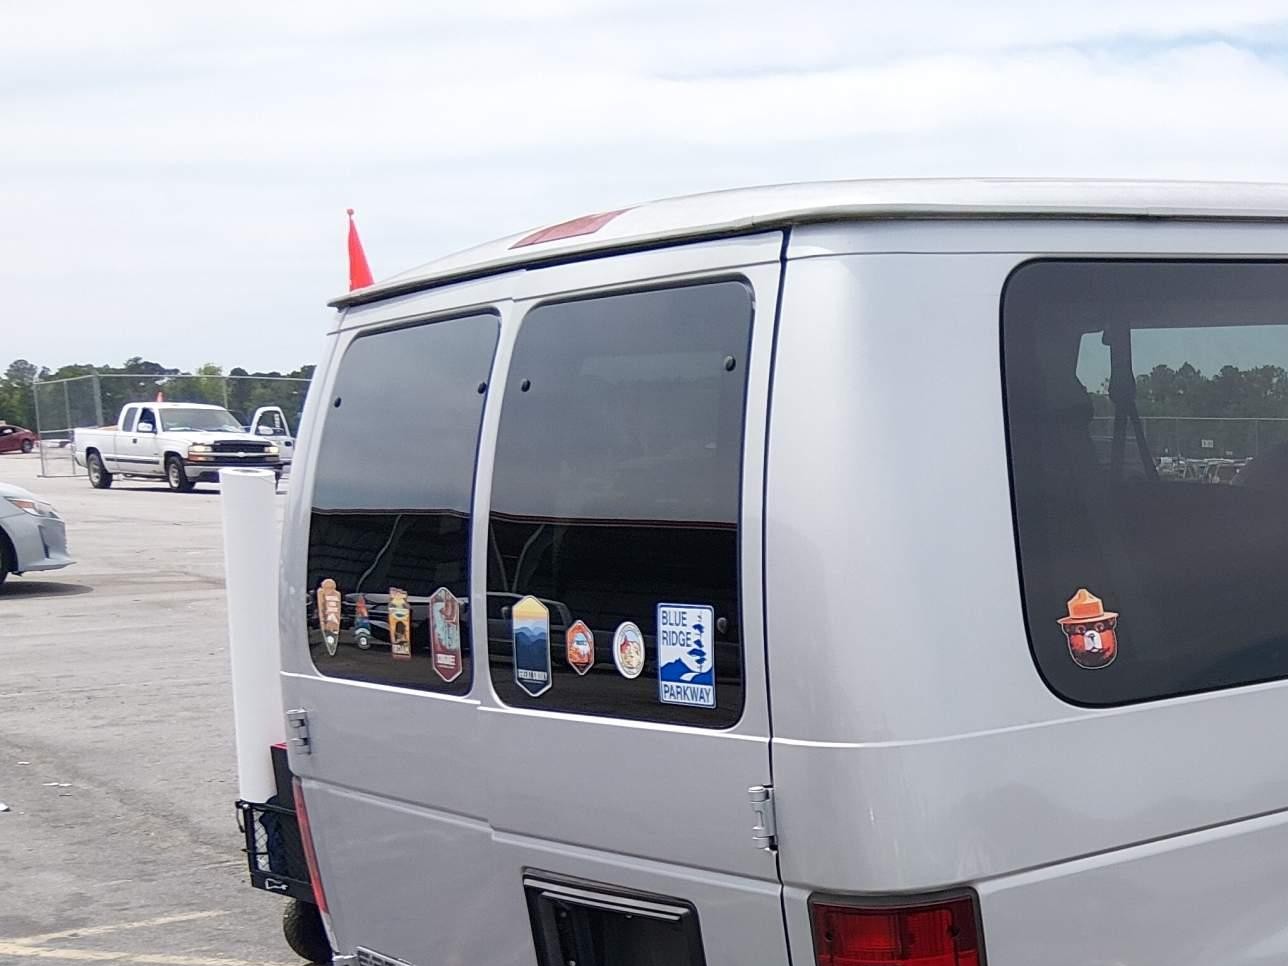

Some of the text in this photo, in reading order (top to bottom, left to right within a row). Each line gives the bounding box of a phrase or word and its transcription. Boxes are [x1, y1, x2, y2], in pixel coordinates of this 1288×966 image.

[661, 610, 688, 628] BLUE
[661, 630, 692, 648] RIDGE
[663, 684, 712, 704] PARKWAY
